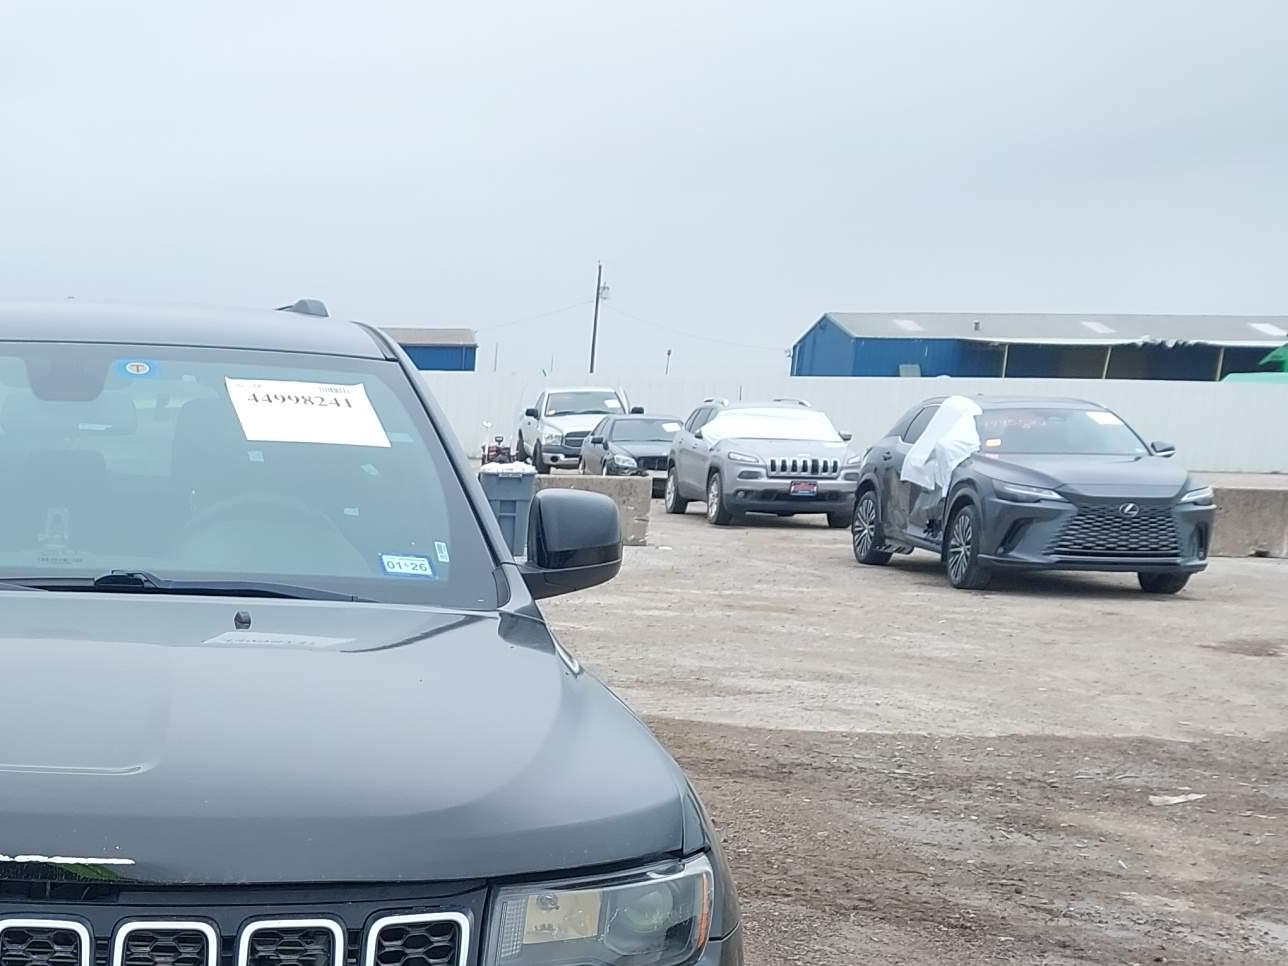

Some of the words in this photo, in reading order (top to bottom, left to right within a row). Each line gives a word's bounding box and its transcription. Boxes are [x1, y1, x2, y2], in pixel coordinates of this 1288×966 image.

[247, 392, 353, 409] 44998241
[386, 560, 403, 570] 01
[410, 562, 428, 572] 26
